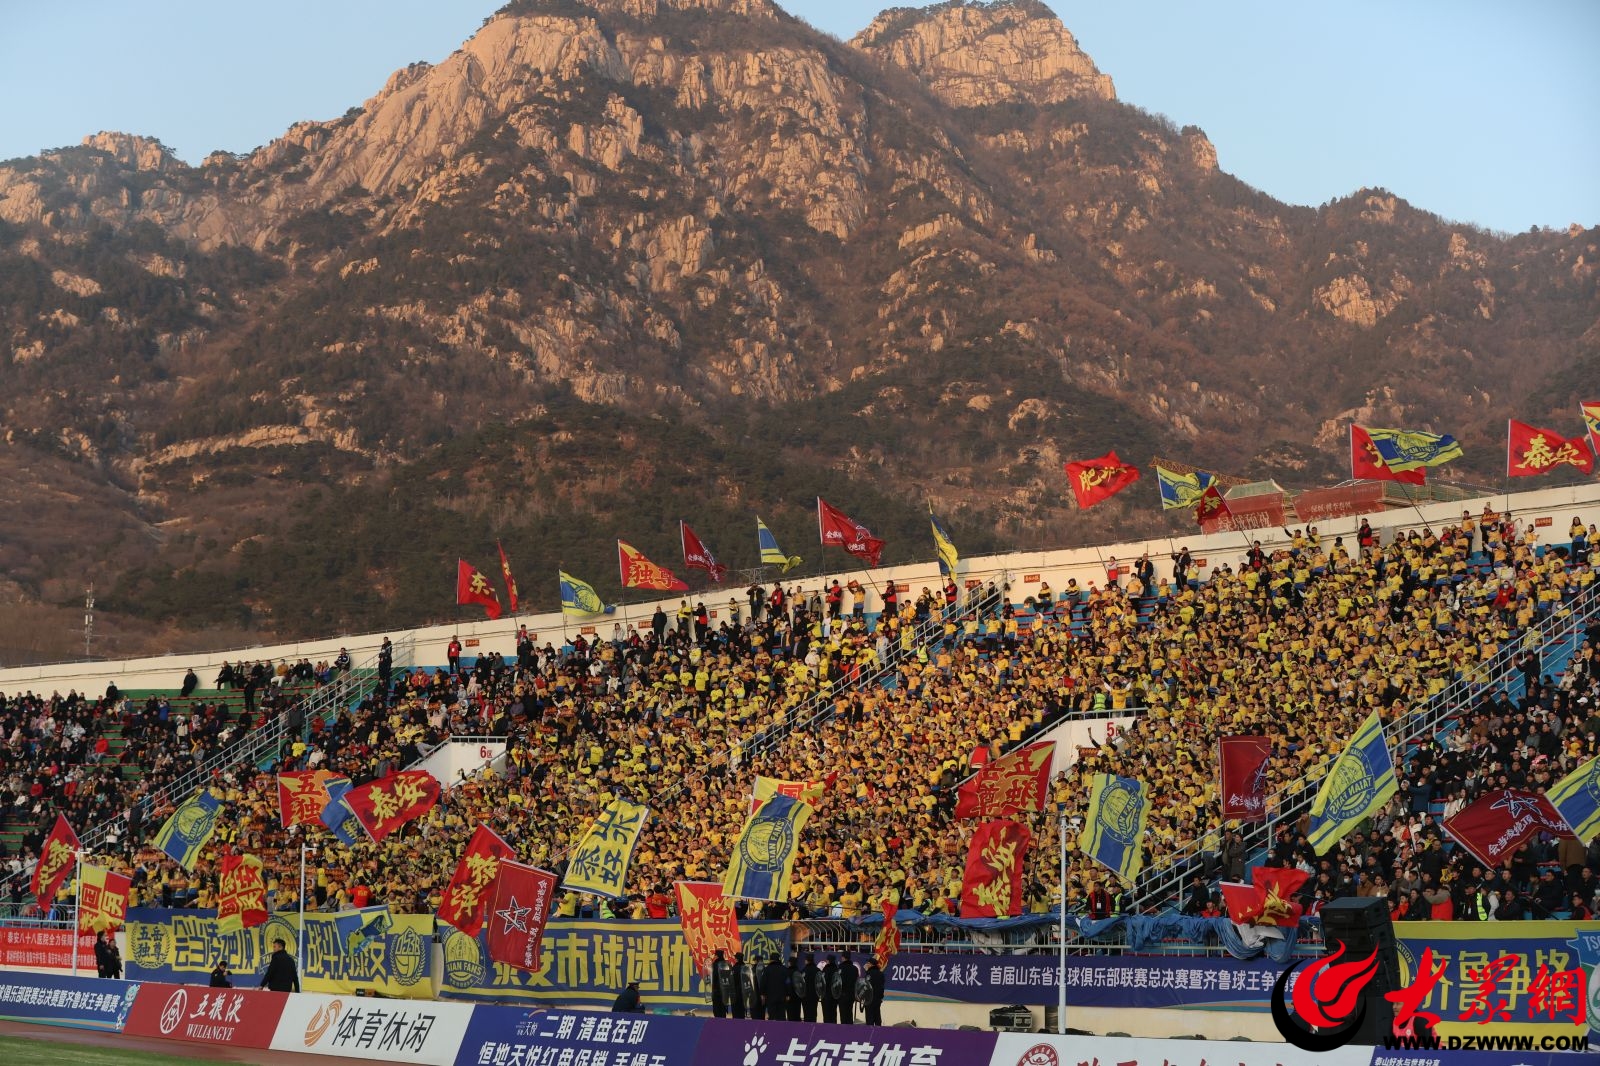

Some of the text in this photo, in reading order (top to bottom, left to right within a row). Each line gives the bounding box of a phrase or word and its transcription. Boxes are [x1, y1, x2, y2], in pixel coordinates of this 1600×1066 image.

[891, 964, 932, 984] 2025年
[186, 1023, 235, 1041] WULIANGYE
[332, 1007, 437, 1053] 体育休闲
[540, 1015, 577, 1040] 二期
[576, 1016, 649, 1045] 清盘在即
